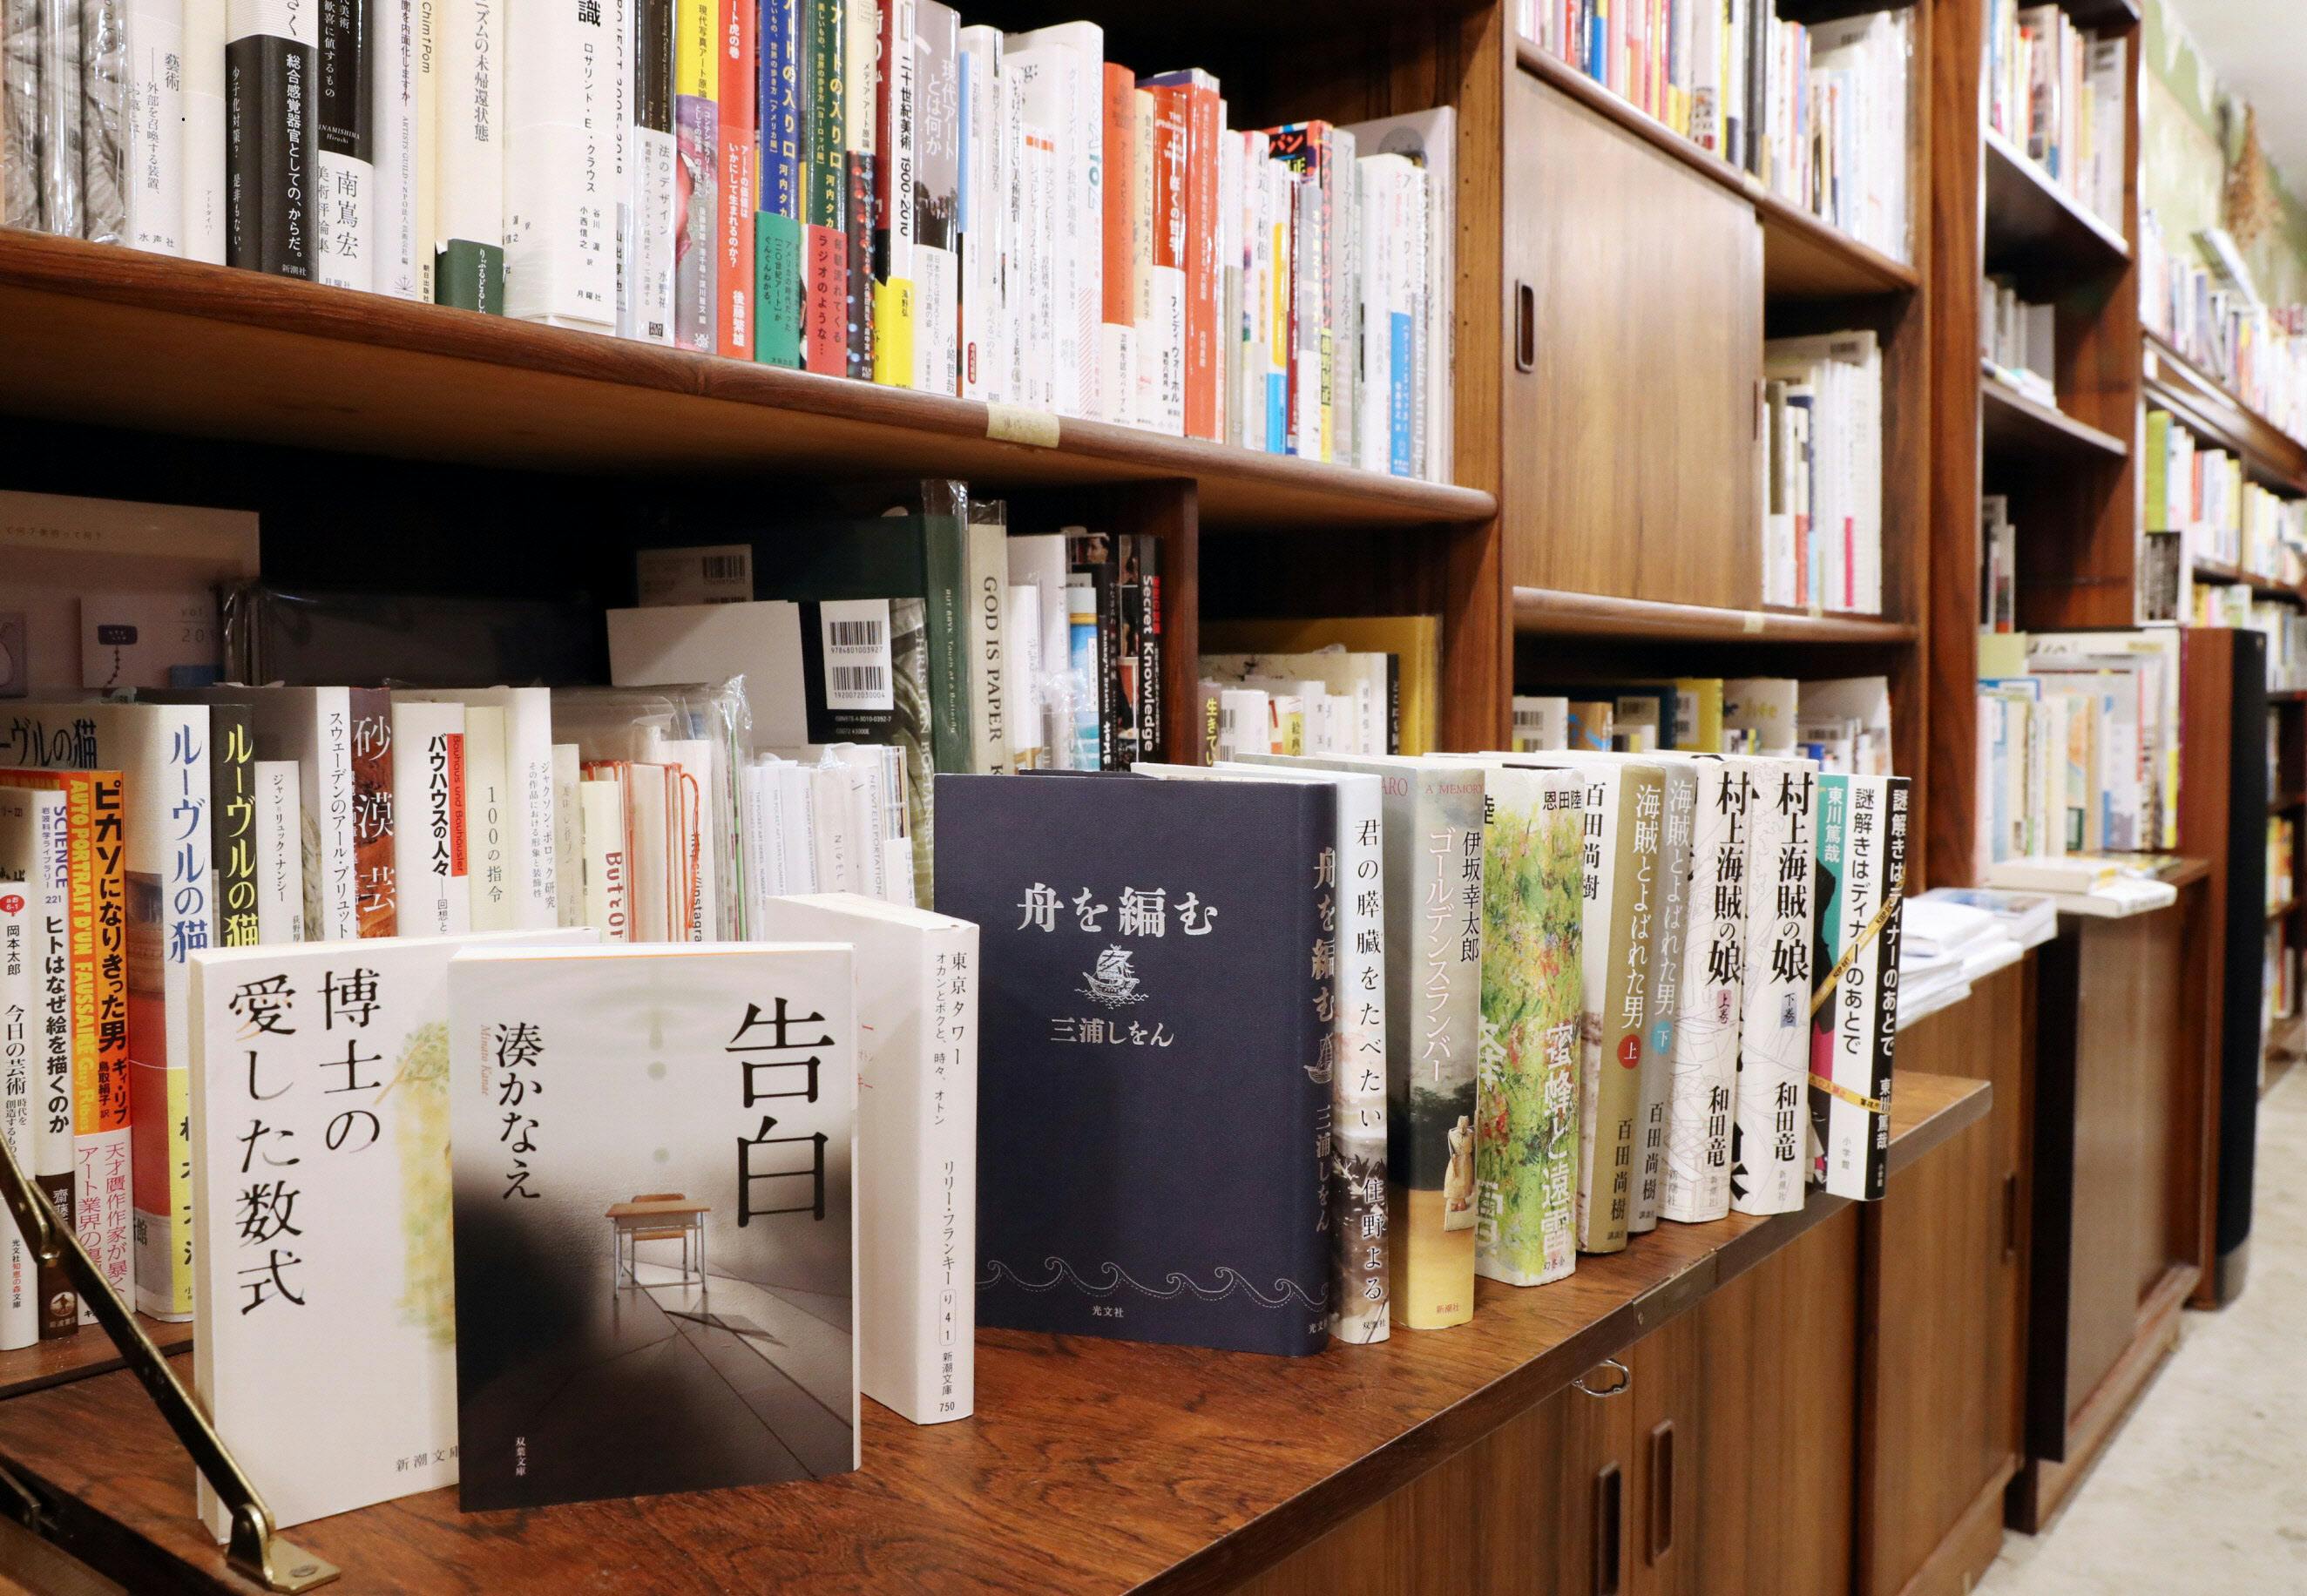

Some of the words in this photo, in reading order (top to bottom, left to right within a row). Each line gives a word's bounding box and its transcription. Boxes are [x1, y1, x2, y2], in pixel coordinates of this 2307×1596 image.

[286, 53, 302, 258] 総合感覚器官としての、からだ。
[925, 73, 941, 157] とは何か
[941, 60, 955, 160] 現代アート
[984, 575, 999, 631] GOD
[985, 639, 1000, 660] IS
[1142, 574, 1154, 634] Secret
[986, 668, 1003, 743] PAPER
[1142, 641, 1155, 753] Knowledge
[53, 805, 68, 889] SCIENCE
[169, 723, 210, 964] ルーヴルの猫
[223, 723, 260, 947] ルーヴルの猫
[329, 712, 349, 940] スウェーデンのアール・ブリュット
[428, 732, 450, 877] バウハウスの人々
[454, 786, 463, 808] und
[487, 786, 504, 903] 100の指令
[541, 761, 556, 909] ジャクソン・ポロック研究
[1543, 790, 1582, 811] 恩田陸
[1582, 781, 1607, 901] 百田尚樹
[1824, 786, 1844, 863] 東川篤哉
[45, 896, 62, 904] 221
[94, 780, 129, 1052] ピカソになりきった男
[1017, 882, 1219, 938] 舟を編む
[1460, 831, 1482, 964] 伊坂幸太郎
[1621, 783, 1661, 1030] 海賊とよばれた男
[1654, 780, 1694, 1016] 海賊とよばれた男
[1705, 771, 1750, 986] 村上海賊の娘
[1769, 771, 1815, 986] 村上海賊の娘
[1843, 788, 1875, 1055] 謎解きはディナーのあとで
[1880, 788, 1909, 1057] 謎解きはディナーのあとで
[6, 924, 22, 977] 岡本太郎
[1310, 847, 1336, 1023] 舟を編む
[1355, 819, 1383, 1127] 君の膵臓をたべたい
[1422, 827, 1456, 1083] ゴールデンスランバー
[44, 915, 70, 1134] ヒトはなぜ絵を描くのか
[480, 1025, 491, 1065] Minato
[934, 952, 948, 1045] オカンとボクと、
[950, 950, 968, 1065] 東京タワー
[1050, 1016, 1174, 1048] 三浦しをん
[1657, 1030, 1670, 1047] 下
[4, 1004, 26, 1097] 今日の芸術
[316, 968, 382, 1155] 博士の
[934, 1052, 947, 1082] 時々、
[1624, 1042, 1638, 1060] 上
[227, 972, 307, 1316] 愛した数式
[495, 1022, 545, 1200] 湊かなえ
[725, 997, 836, 1228] 告白
[934, 1089, 946, 1126] オトン
[1642, 1101, 1664, 1202] 百田尚樹
[1707, 1085, 1729, 1167] 和田竜
[1775, 1081, 1798, 1163] 和田竜
[1842, 1136, 1852, 1171] 小学館
[1876, 1078, 1891, 1150] 東川篤哉
[1316, 1104, 1332, 1233] 三浦しをん
[1610, 1118, 1633, 1221] 百田尚樹
[941, 1161, 957, 1286] リリー・フランキー
[1362, 1178, 1388, 1301] 住野よる
[1092, 1305, 1125, 1318] 光文社
[939, 1401, 955, 1412] 750
[942, 1351, 954, 1396] 新潮文庫
